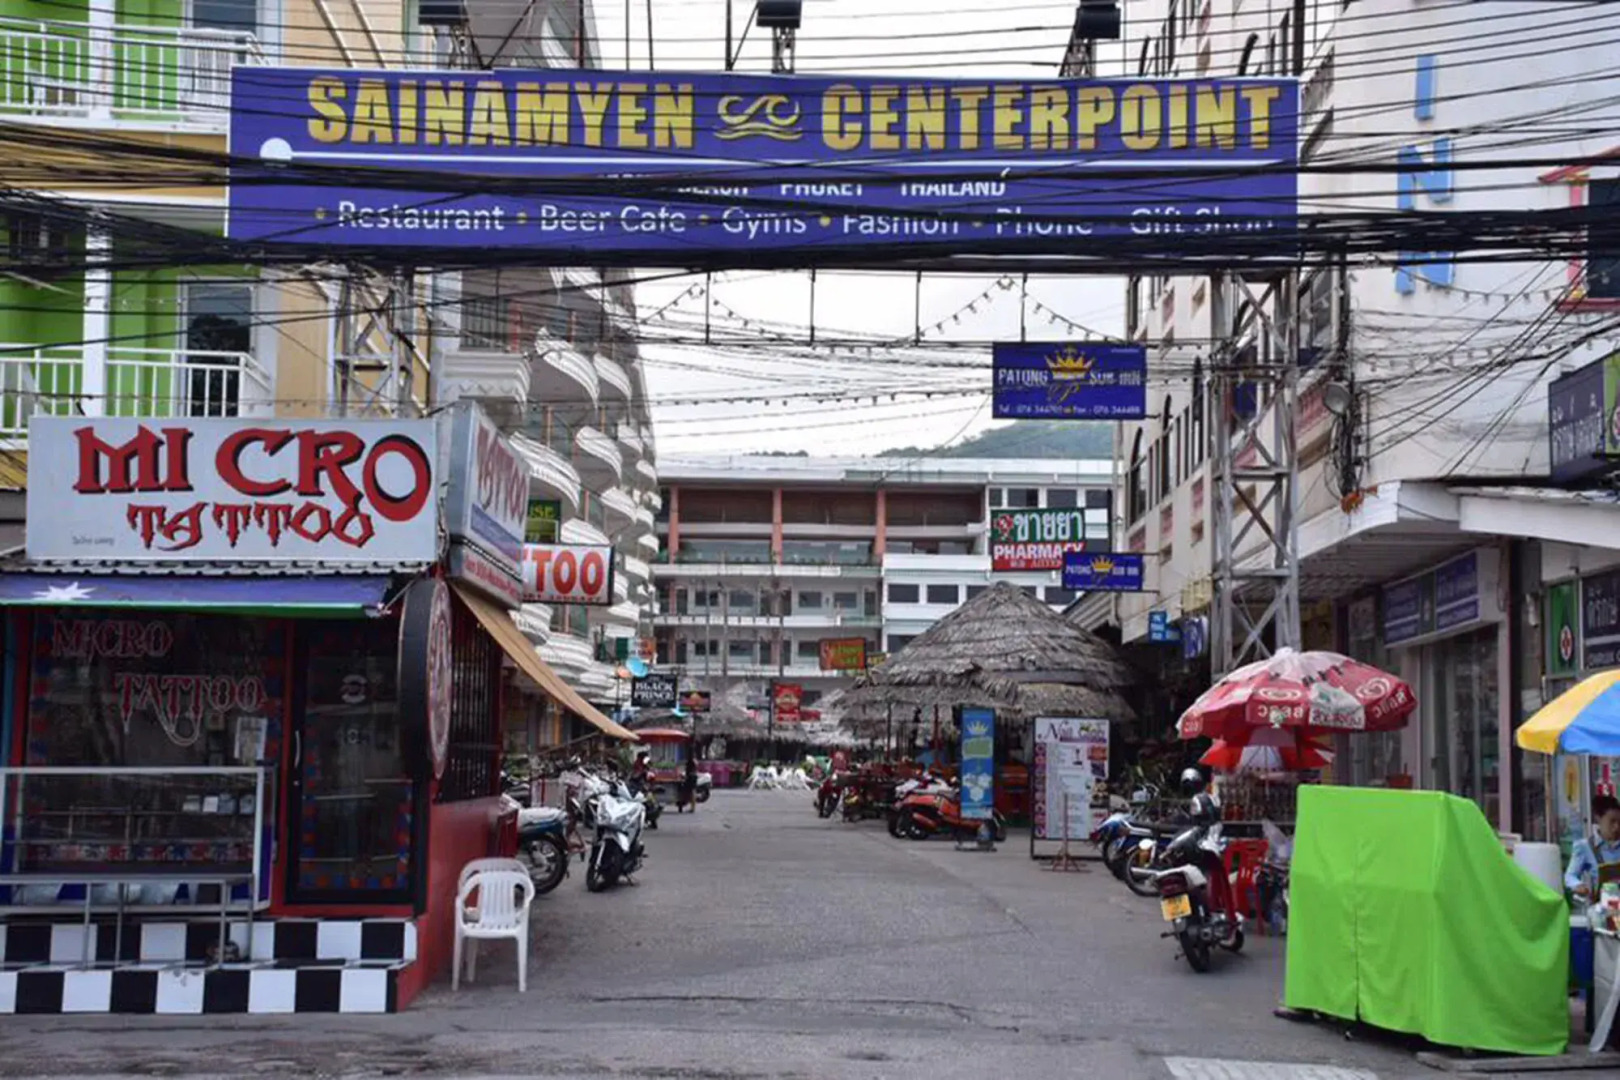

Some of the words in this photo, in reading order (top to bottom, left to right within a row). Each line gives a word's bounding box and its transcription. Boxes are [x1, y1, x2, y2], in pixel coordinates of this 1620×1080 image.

[305, 76, 697, 150] SAINAMYEN
[821, 82, 1281, 152] CENTERPOINT
[338, 201, 505, 232] Restaurant
[541, 203, 606, 232] Beer
[722, 206, 806, 239] Gyms
[843, 211, 959, 235] Fashion
[998, 369, 1049, 387] PATONG
[126, 502, 375, 551] TATTOO
[1013, 511, 1083, 542] ขายยา
[994, 542, 1085, 560] PHARMACY
[523, 549, 604, 596] TOO
[51, 619, 174, 659] MICRO
[114, 672, 268, 736] TATTOO
